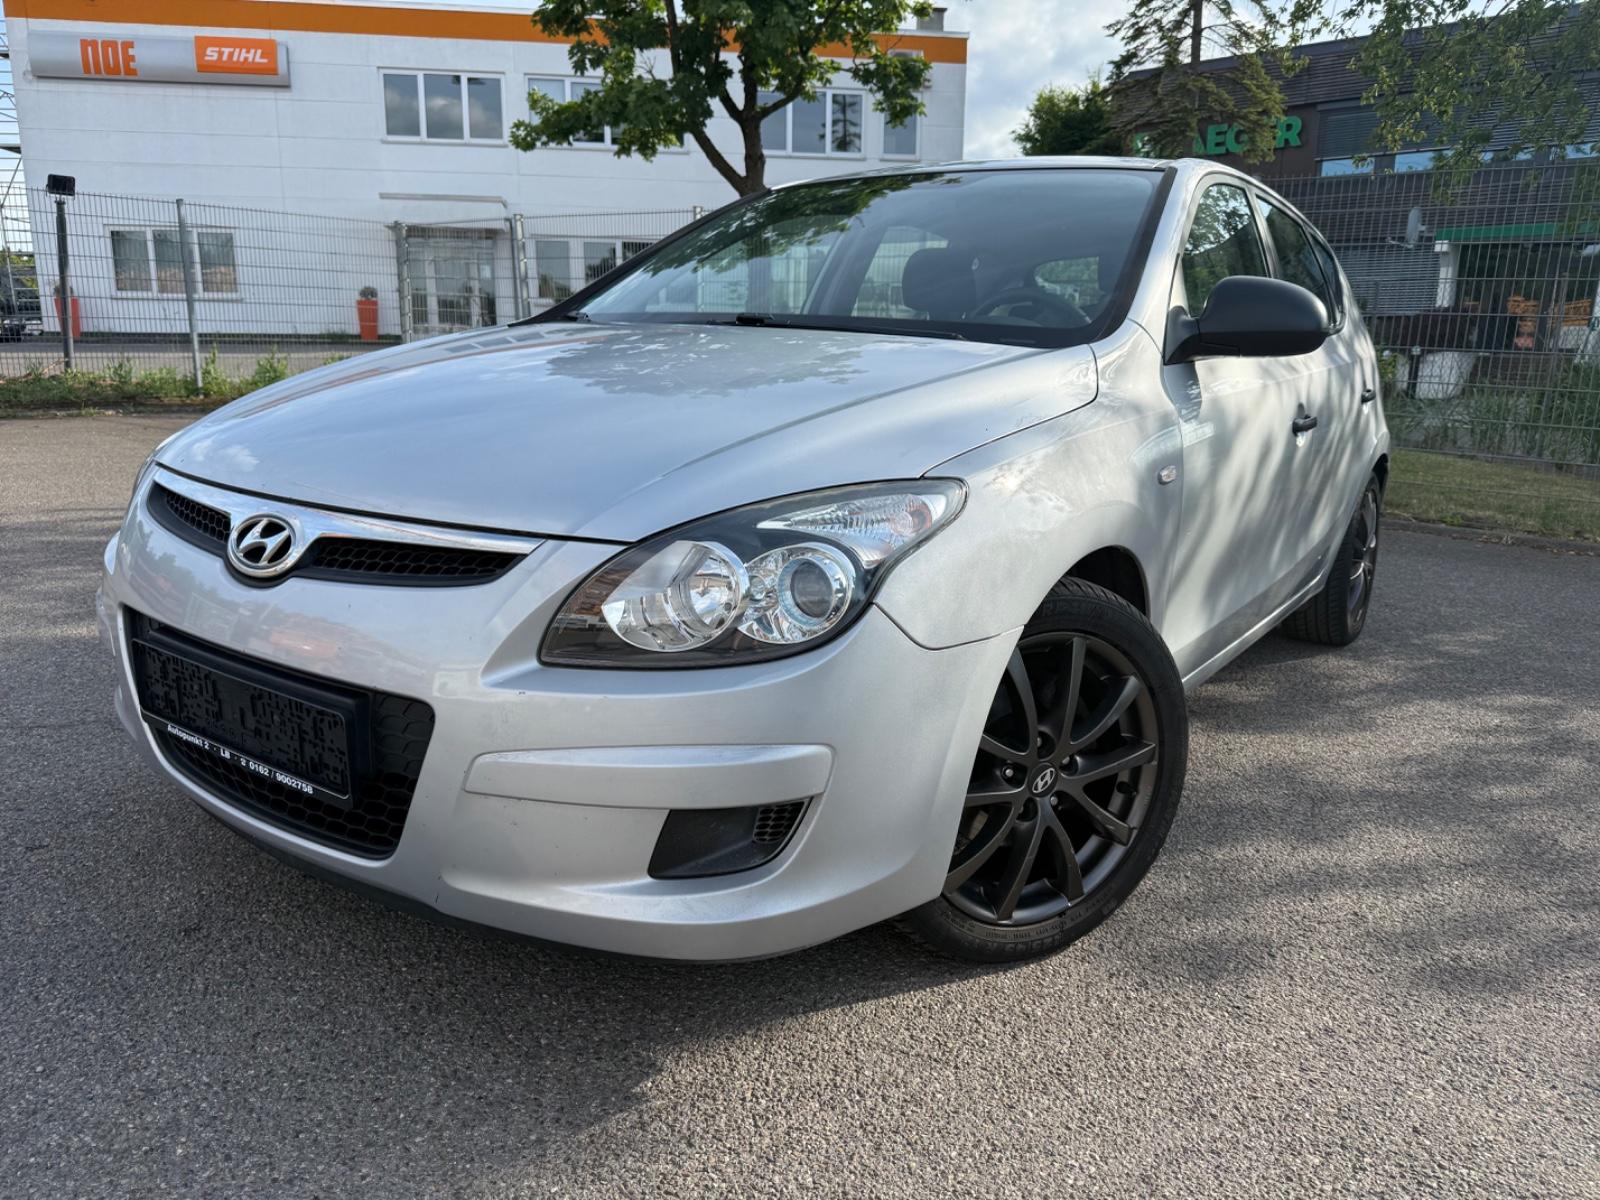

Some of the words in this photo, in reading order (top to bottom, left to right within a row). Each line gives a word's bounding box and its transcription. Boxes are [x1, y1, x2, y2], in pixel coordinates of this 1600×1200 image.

[204, 46, 268, 63] STIHL
[168, 724, 203, 747] Autopunkt
[249, 761, 270, 777] 0162
